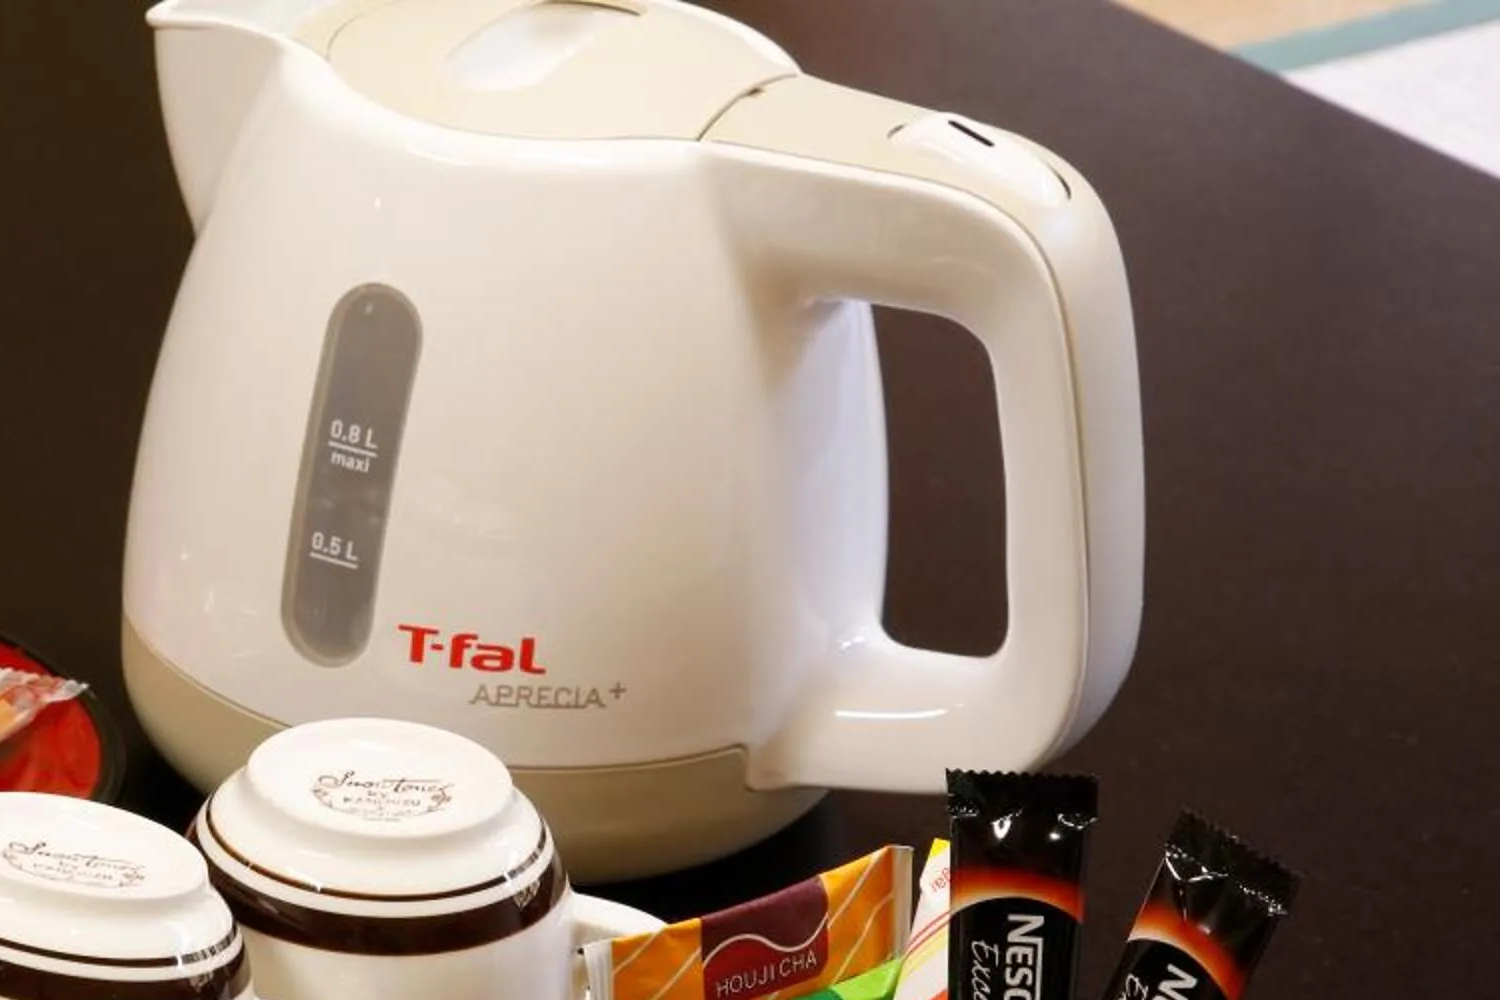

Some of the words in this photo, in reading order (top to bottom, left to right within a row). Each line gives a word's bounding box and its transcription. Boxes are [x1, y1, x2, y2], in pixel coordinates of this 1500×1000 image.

[330, 419, 361, 444] 0.8
[366, 425, 378, 449] L
[331, 451, 370, 473] maxi
[311, 532, 342, 556] 0.5
[346, 538, 358, 561] L
[398, 624, 547, 676] T-fal
[715, 963, 775, 999] HOUJI
[779, 948, 818, 977] CHA
